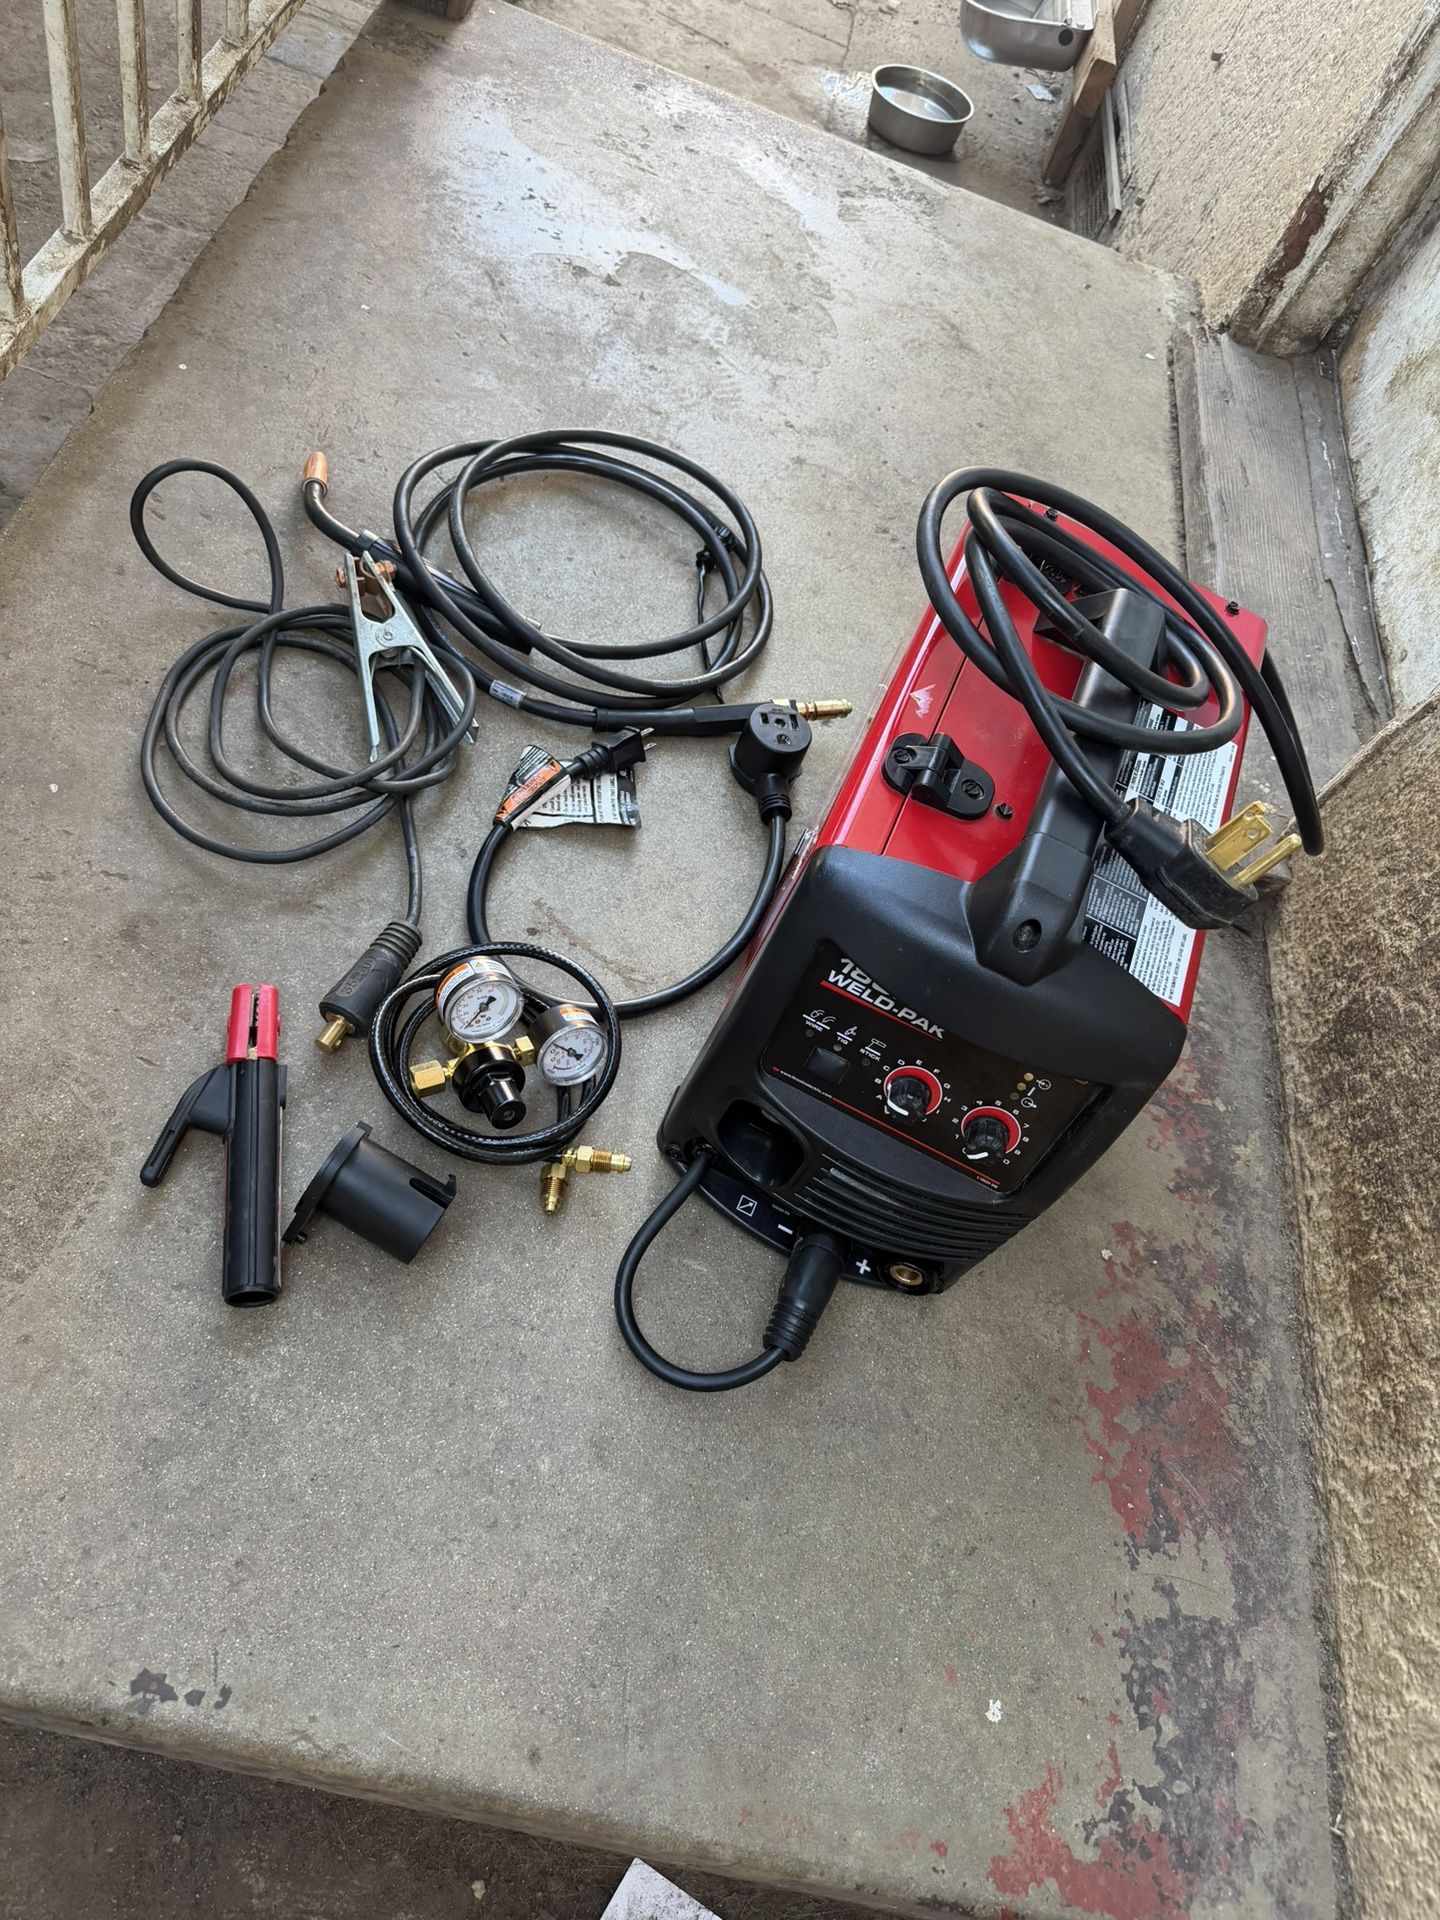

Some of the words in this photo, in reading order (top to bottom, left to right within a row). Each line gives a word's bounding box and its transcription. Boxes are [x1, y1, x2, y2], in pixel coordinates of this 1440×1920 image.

[827, 969, 945, 1040] WELD-PAK
[805, 1019, 824, 1033] WIRE
[836, 1036, 849, 1046] TIG
[859, 1048, 881, 1062] STICK
